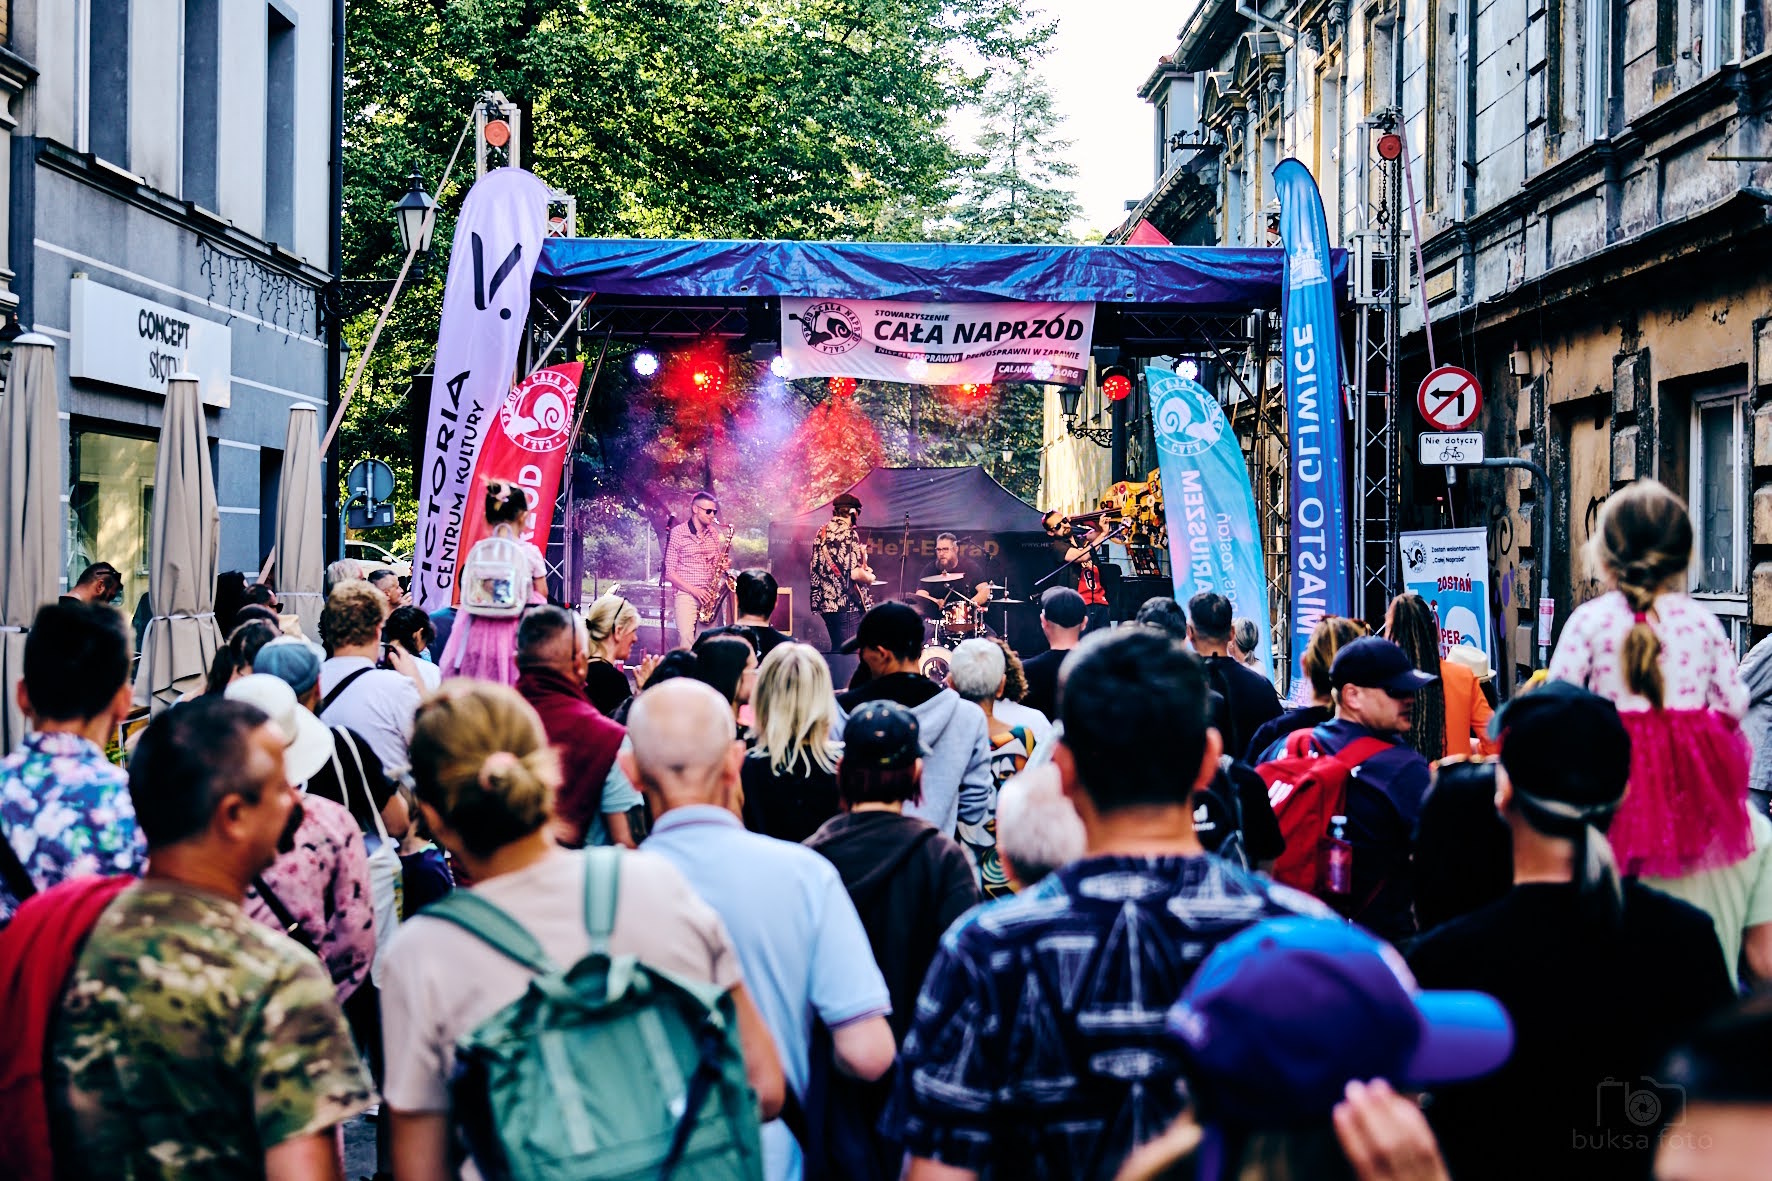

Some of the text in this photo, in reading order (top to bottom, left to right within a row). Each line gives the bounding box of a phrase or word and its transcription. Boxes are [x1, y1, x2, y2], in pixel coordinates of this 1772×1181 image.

[874, 309, 949, 321] STOWARZYSZENIE
[874, 312, 1084, 344] CAŁA NAPRZÓD
[139, 308, 190, 349] CONCEPT
[532, 372, 561, 386] CAŁA
[1425, 437, 1479, 446] Nie dotyczy
[419, 369, 471, 606] VICTORIA
[436, 399, 485, 589] CENTRUM KULTURY
[1437, 572, 1473, 593] ZOSTAŃ
